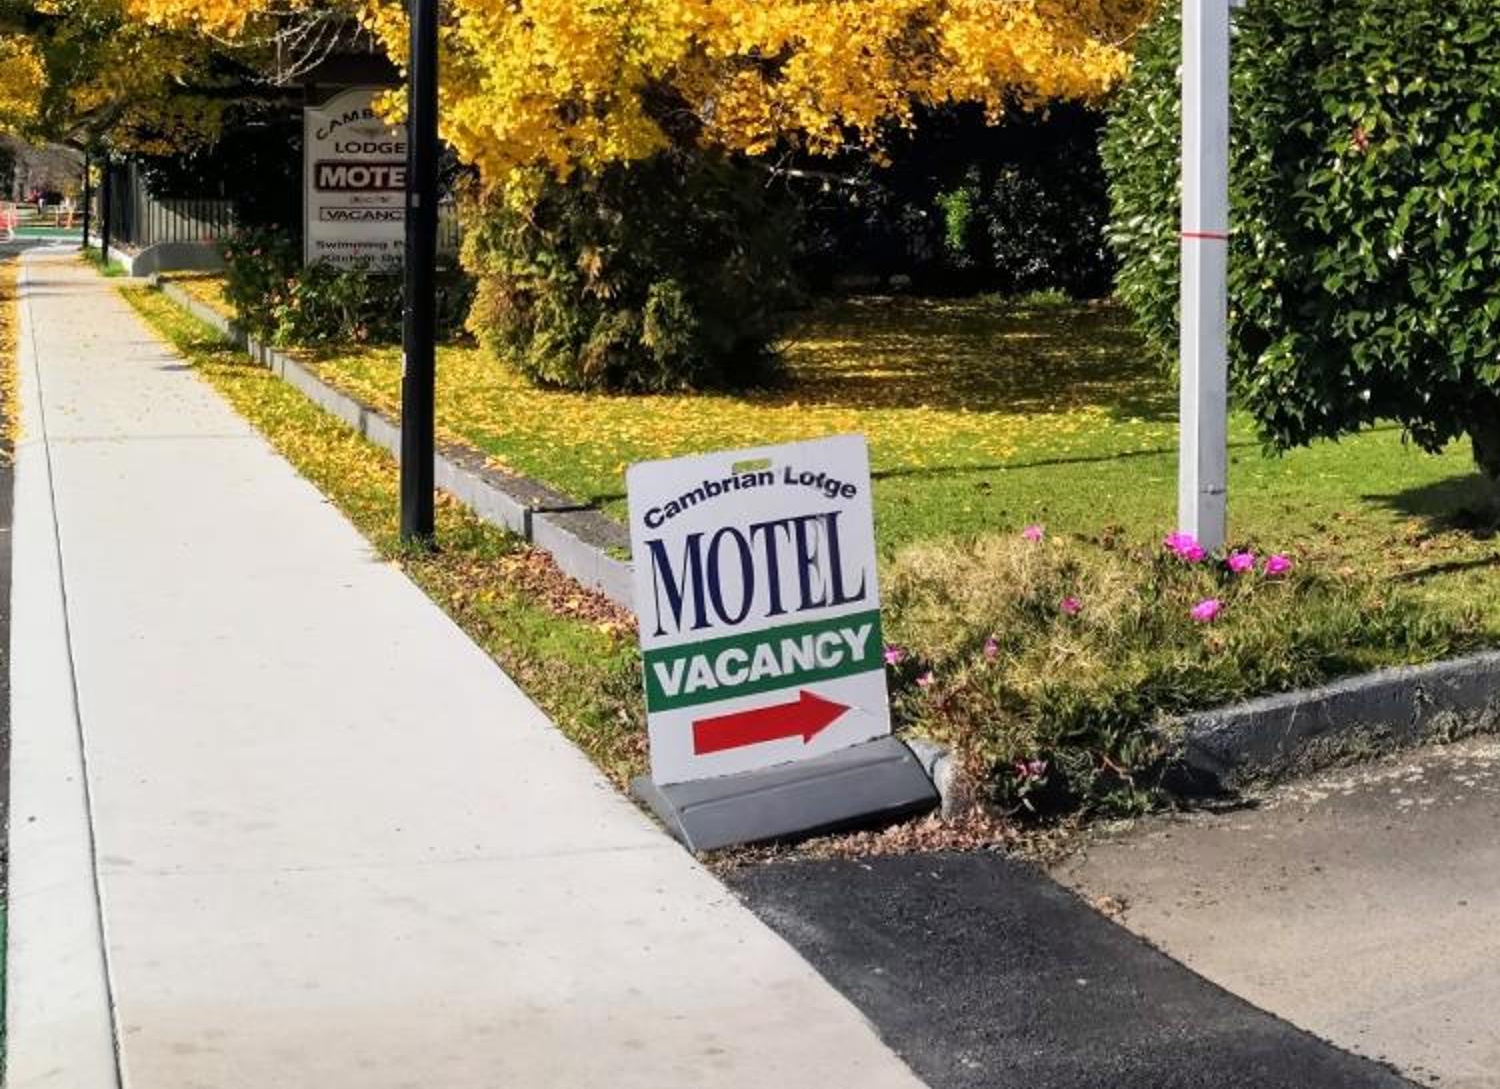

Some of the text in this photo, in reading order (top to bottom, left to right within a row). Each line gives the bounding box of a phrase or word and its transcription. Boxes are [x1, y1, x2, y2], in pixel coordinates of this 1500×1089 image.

[335, 142, 407, 154] LODGE
[320, 166, 407, 188] MOTE
[327, 210, 404, 220] VACANC
[643, 470, 774, 529] Cambrian
[643, 511, 866, 637] MOTEL
[653, 623, 872, 697] VACANCY
